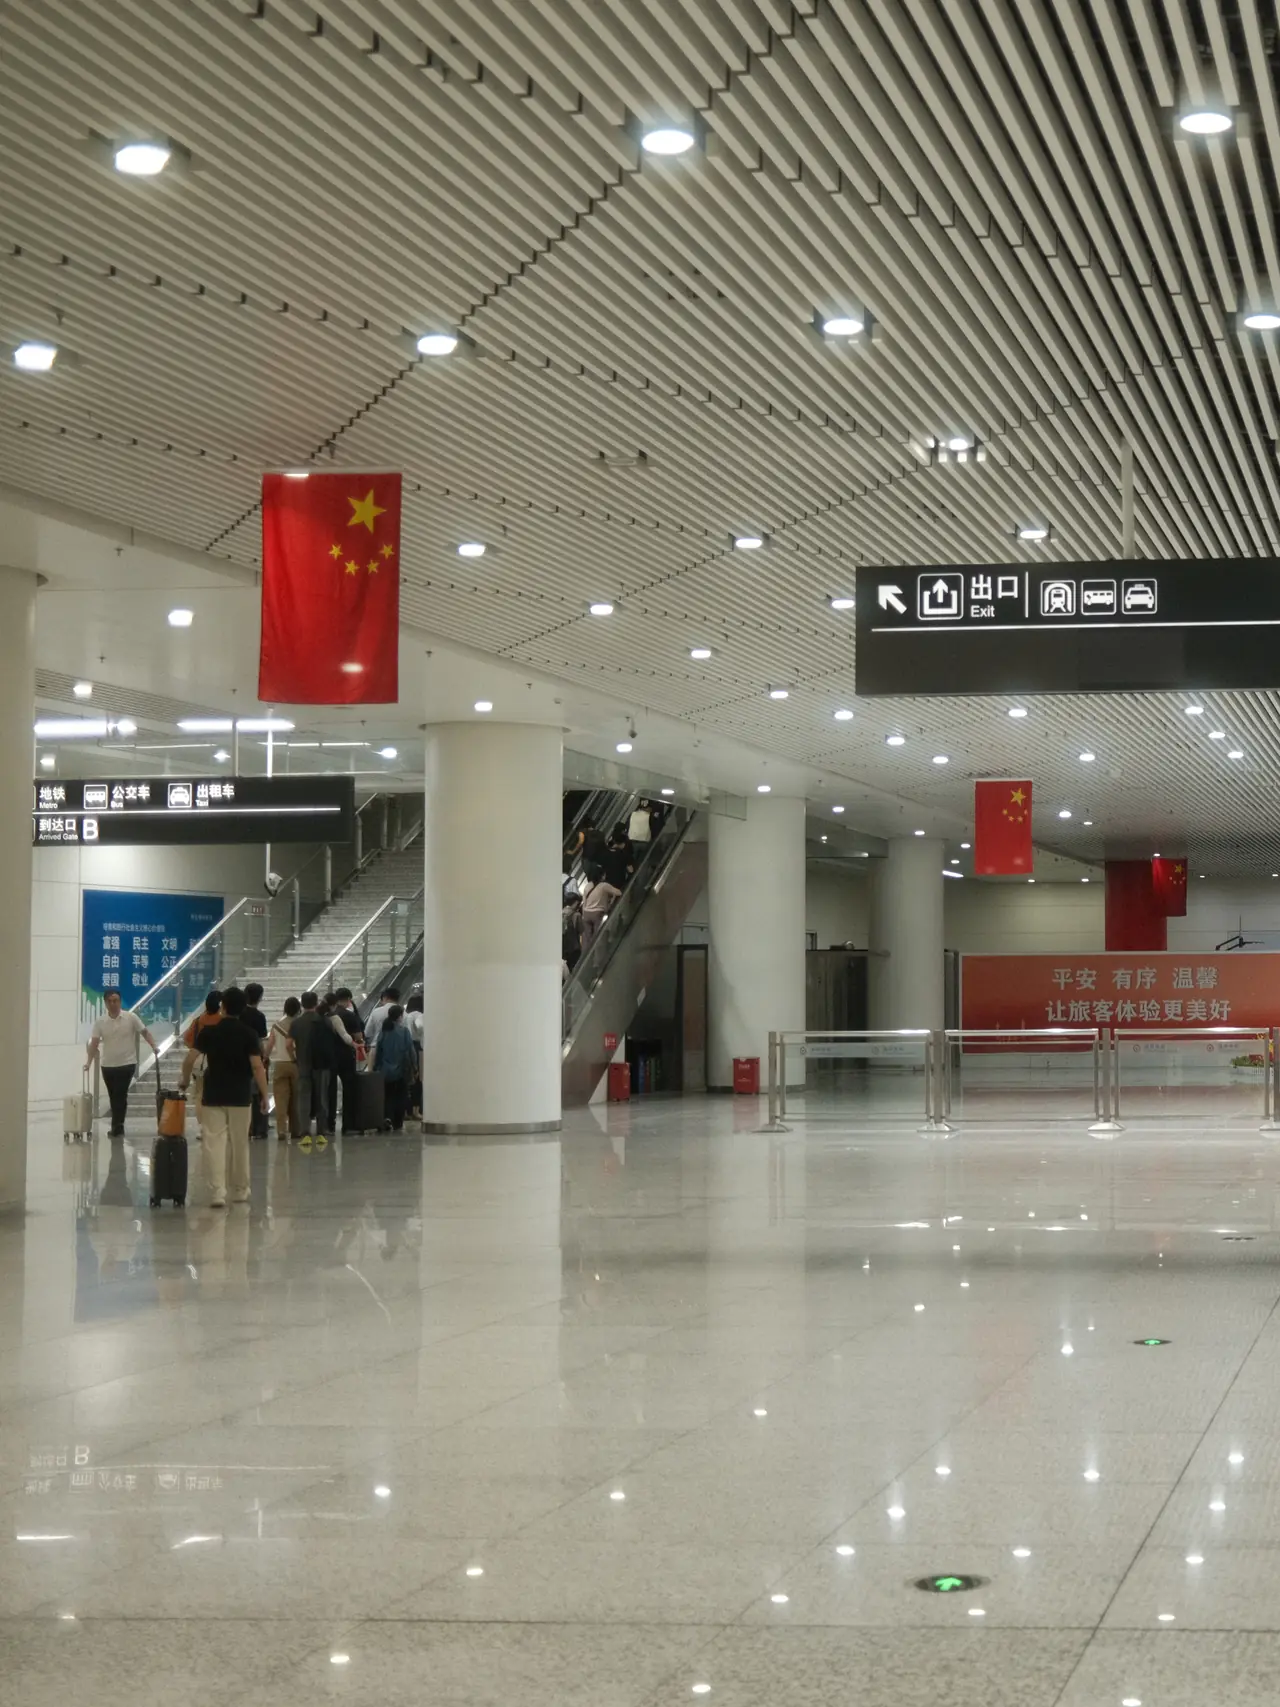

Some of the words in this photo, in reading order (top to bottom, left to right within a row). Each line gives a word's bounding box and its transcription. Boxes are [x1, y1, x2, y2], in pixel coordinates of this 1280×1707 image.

[970, 574, 1019, 600] 出口
[970, 604, 996, 618] Exit
[39, 786, 66, 800] 地铁
[112, 785, 150, 800] 公交车
[197, 784, 235, 798] 出租车
[111, 801, 123, 809] Bus
[39, 819, 77, 831] 到达口
[83, 819, 98, 840] B
[103, 936, 120, 949] 富强
[132, 936, 149, 950] 民主
[103, 955, 119, 968] 自由
[132, 955, 149, 968] 平等
[102, 973, 119, 986] 爱国
[132, 973, 148, 986] 敬业
[1052, 968, 1096, 990] 平安
[1112, 967, 1157, 989] 有序
[1172, 967, 1218, 989] 温馨
[1045, 1000, 1231, 1022] 让旅客体验更美好
